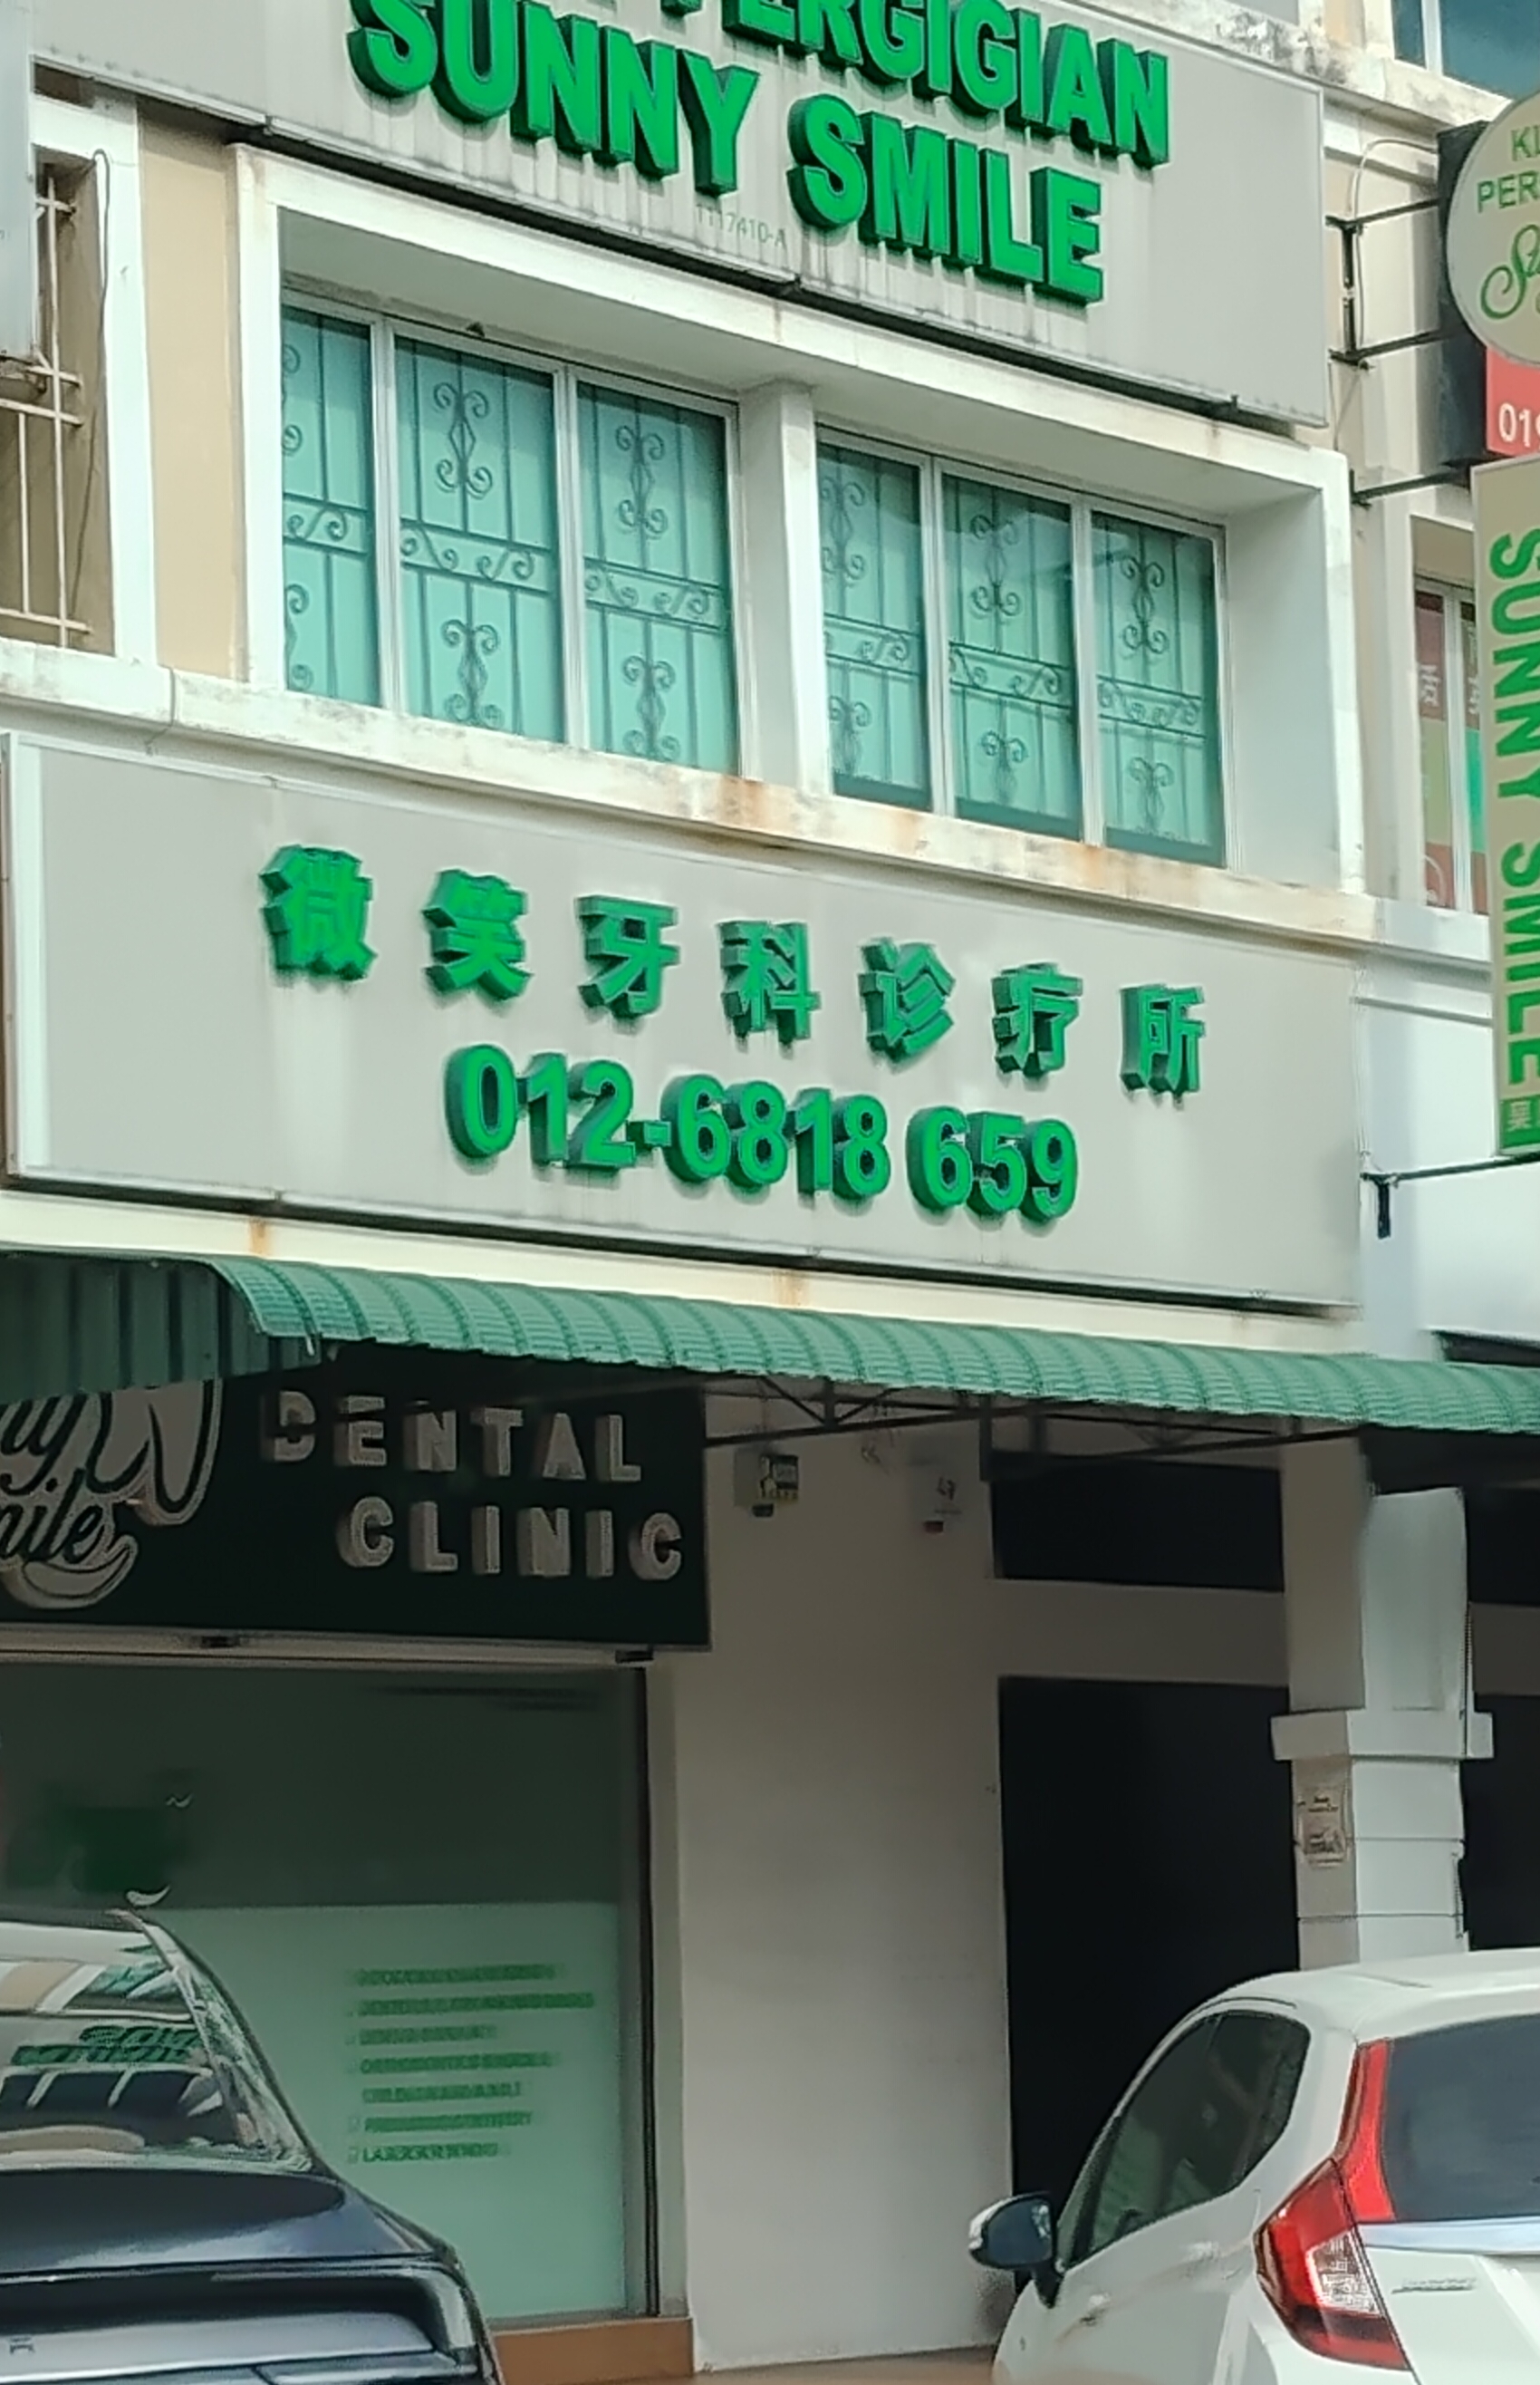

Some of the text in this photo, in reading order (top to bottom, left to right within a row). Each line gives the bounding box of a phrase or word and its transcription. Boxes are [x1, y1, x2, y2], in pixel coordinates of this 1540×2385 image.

[661, 0, 1169, 169] RGIGIAN
[346, 0, 1103, 306] SUNNY SMILE
[1477, 169, 1540, 213] PER
[1498, 402, 1540, 448] 01
[261, 844, 1206, 1106] 微笑牙科诊疗所
[444, 1043, 1080, 1223] 012-6818 659
[263, 1388, 643, 1483] DENTAL
[336, 1495, 684, 1581] CLINIC
